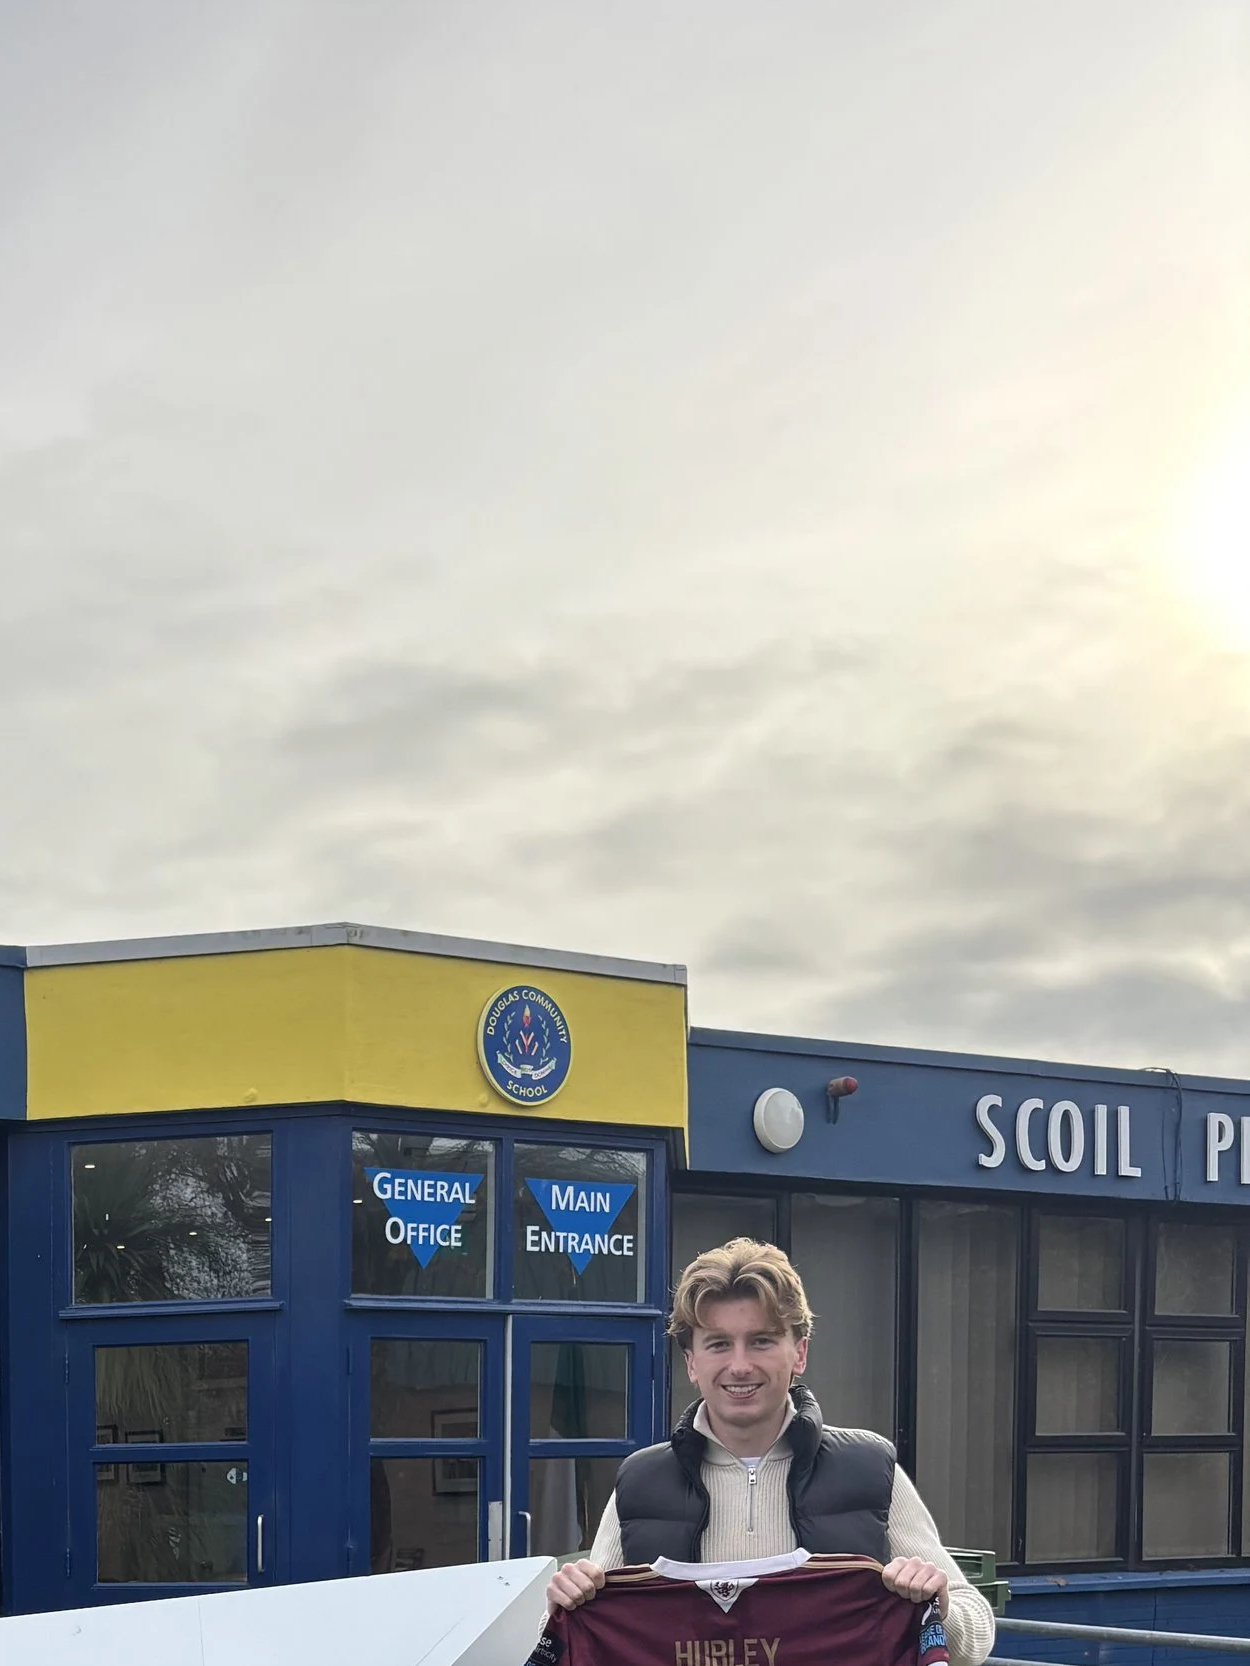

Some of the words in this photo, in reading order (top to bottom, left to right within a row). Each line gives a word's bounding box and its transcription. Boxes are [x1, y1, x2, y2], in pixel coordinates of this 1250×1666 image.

[487, 990, 520, 1035] DOUGLAS
[521, 989, 568, 1043] COMMUNITY
[506, 1080, 548, 1097] SCHOOL
[976, 1094, 1142, 1177] SCOIL
[1206, 1112, 1250, 1185] P
[372, 1172, 476, 1205] GENERAL
[551, 1184, 610, 1213] MAIN
[384, 1216, 462, 1247] OFFICE
[526, 1225, 634, 1257] ENTRANCE
